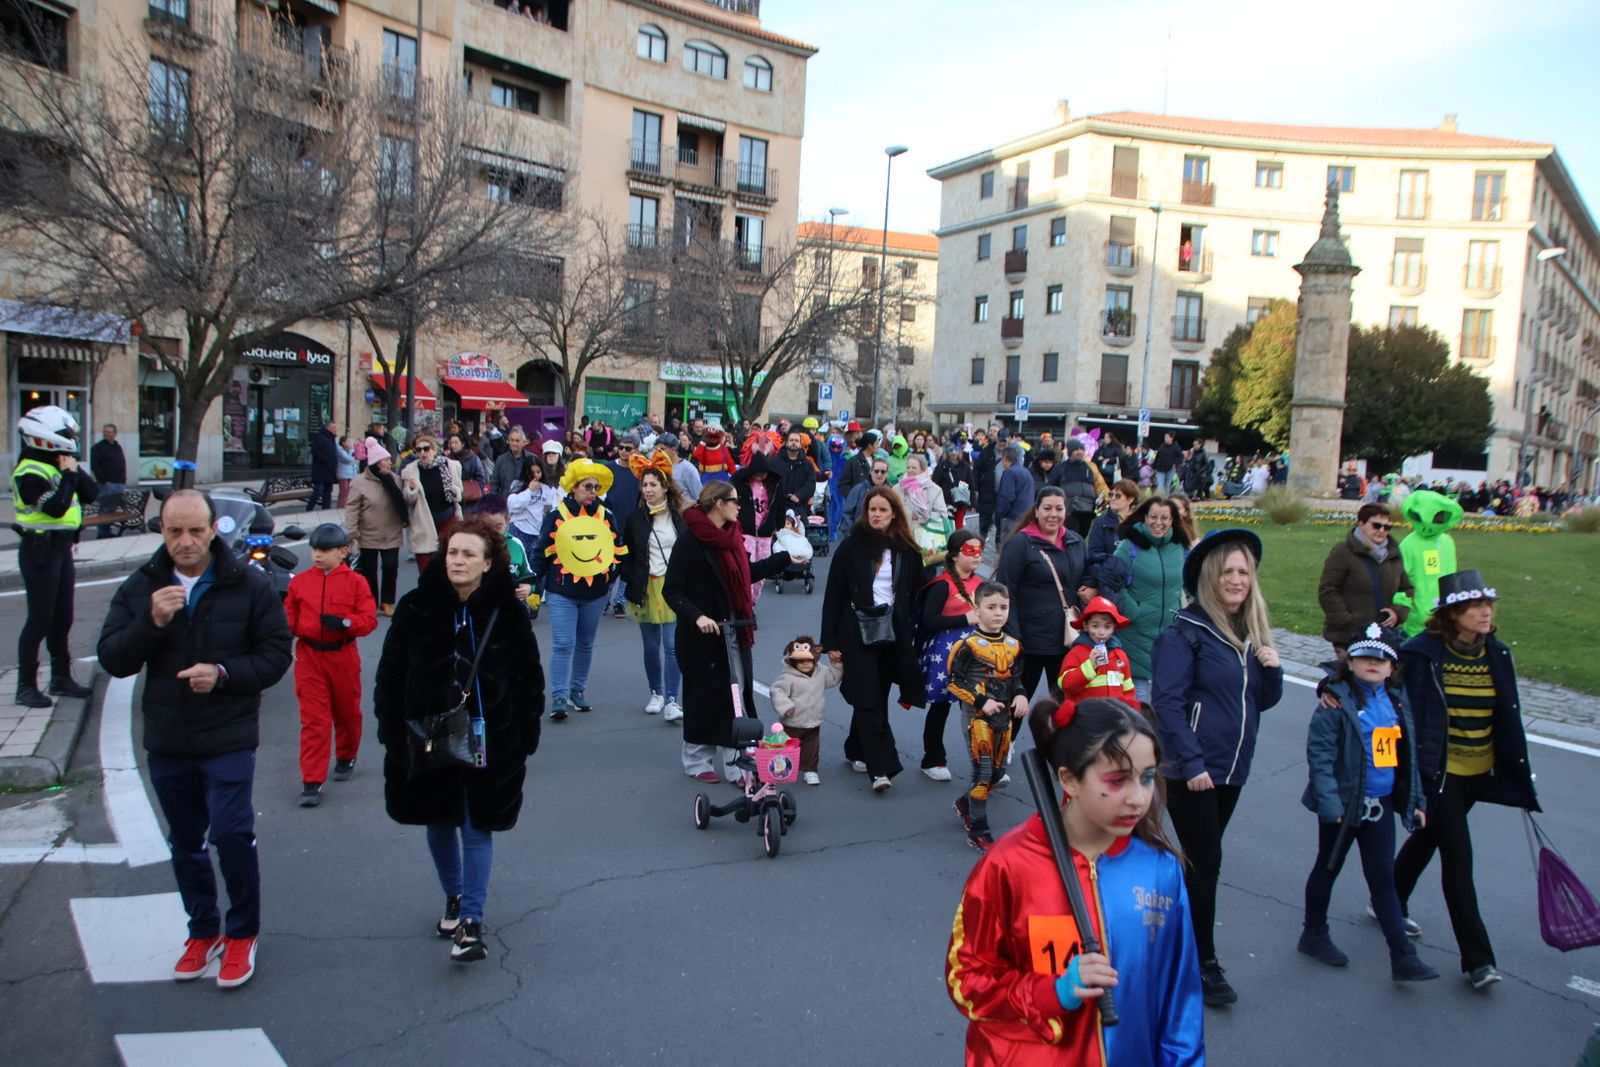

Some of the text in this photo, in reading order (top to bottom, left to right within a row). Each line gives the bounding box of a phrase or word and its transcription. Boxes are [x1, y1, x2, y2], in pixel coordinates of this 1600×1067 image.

[299, 348, 330, 364] Alysa
[821, 385, 831, 398] P
[1018, 397, 1027, 409] P
[1376, 737, 1391, 756] 41
[1132, 886, 1173, 911] Joker
